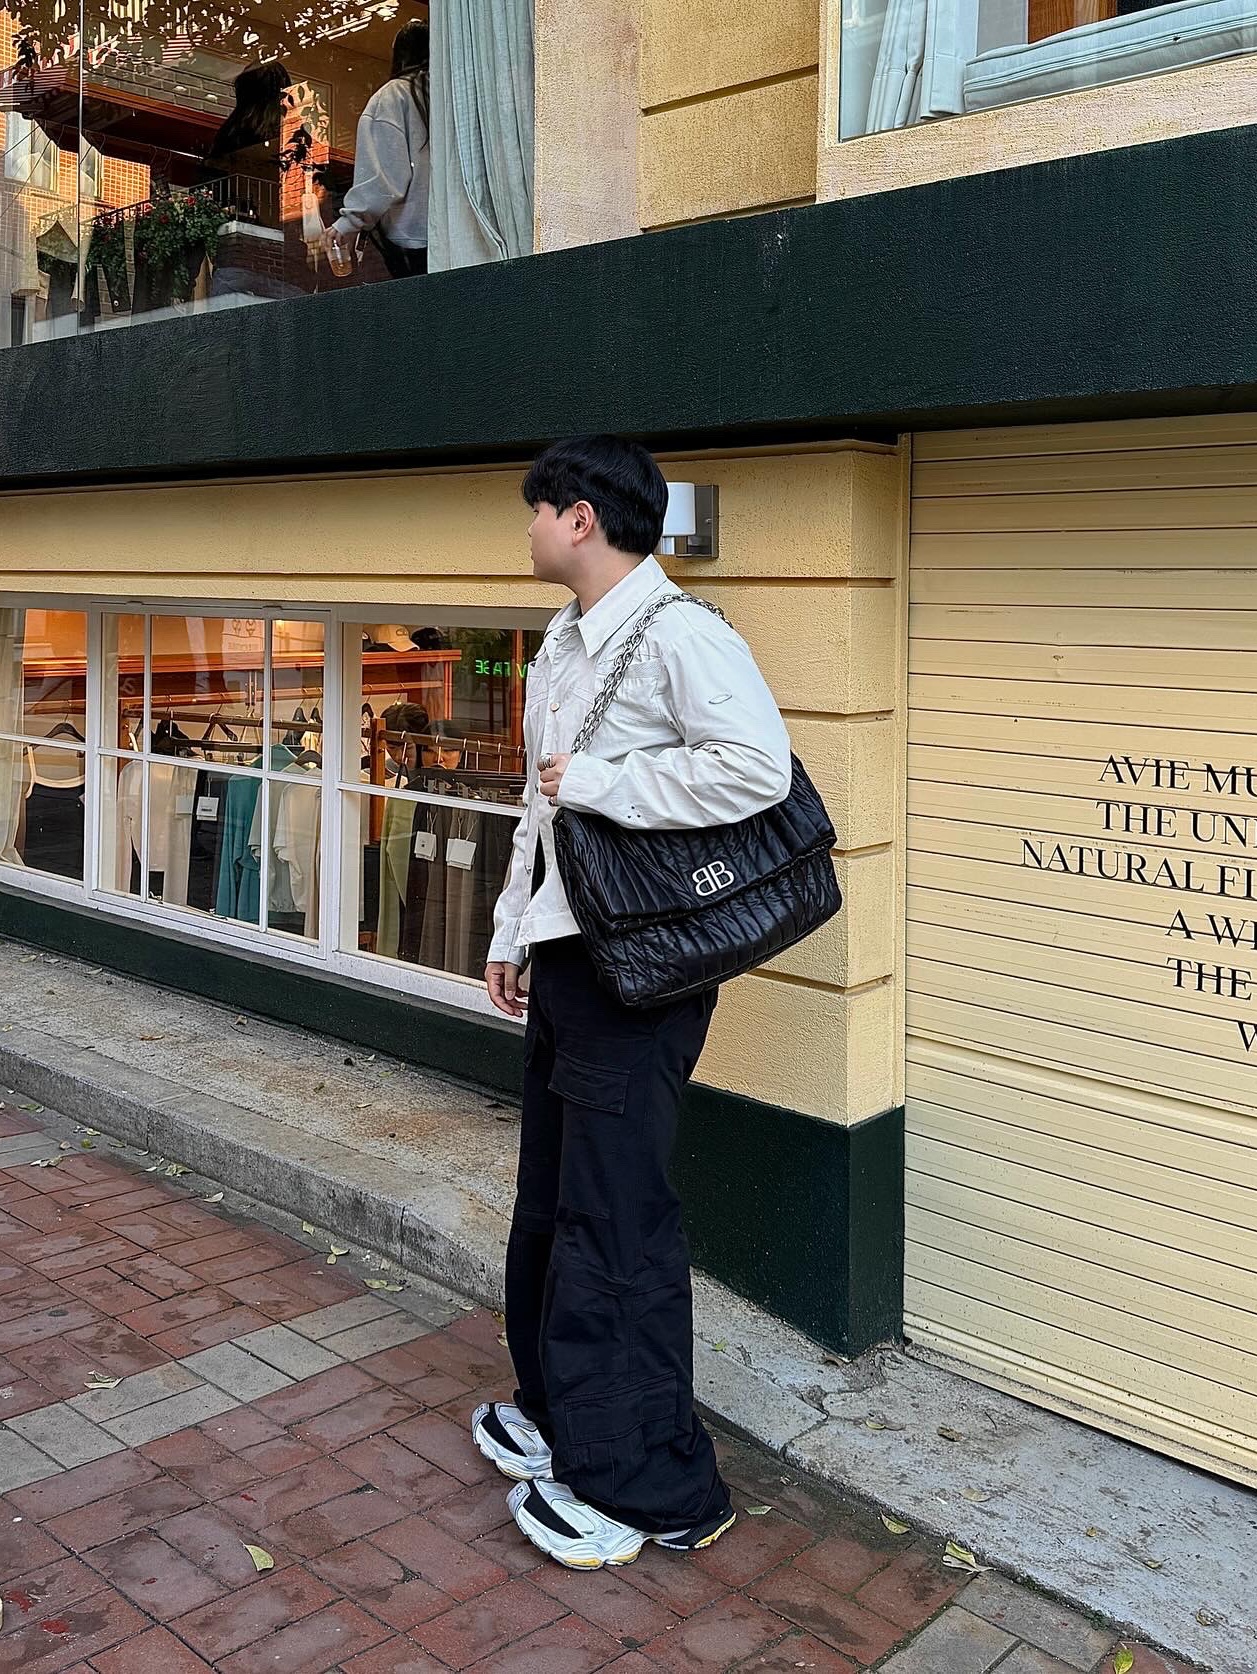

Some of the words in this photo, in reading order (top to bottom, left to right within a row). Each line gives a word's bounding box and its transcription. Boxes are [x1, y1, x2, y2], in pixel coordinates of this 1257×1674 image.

[1097, 754, 1190, 791] AVIE
[1202, 762, 1257, 798] MU
[1095, 801, 1177, 838] THE
[1189, 811, 1257, 849] UN
[1020, 838, 1205, 892] NATURAL
[1164, 908, 1196, 942] A
[1166, 956, 1252, 1002] THE
